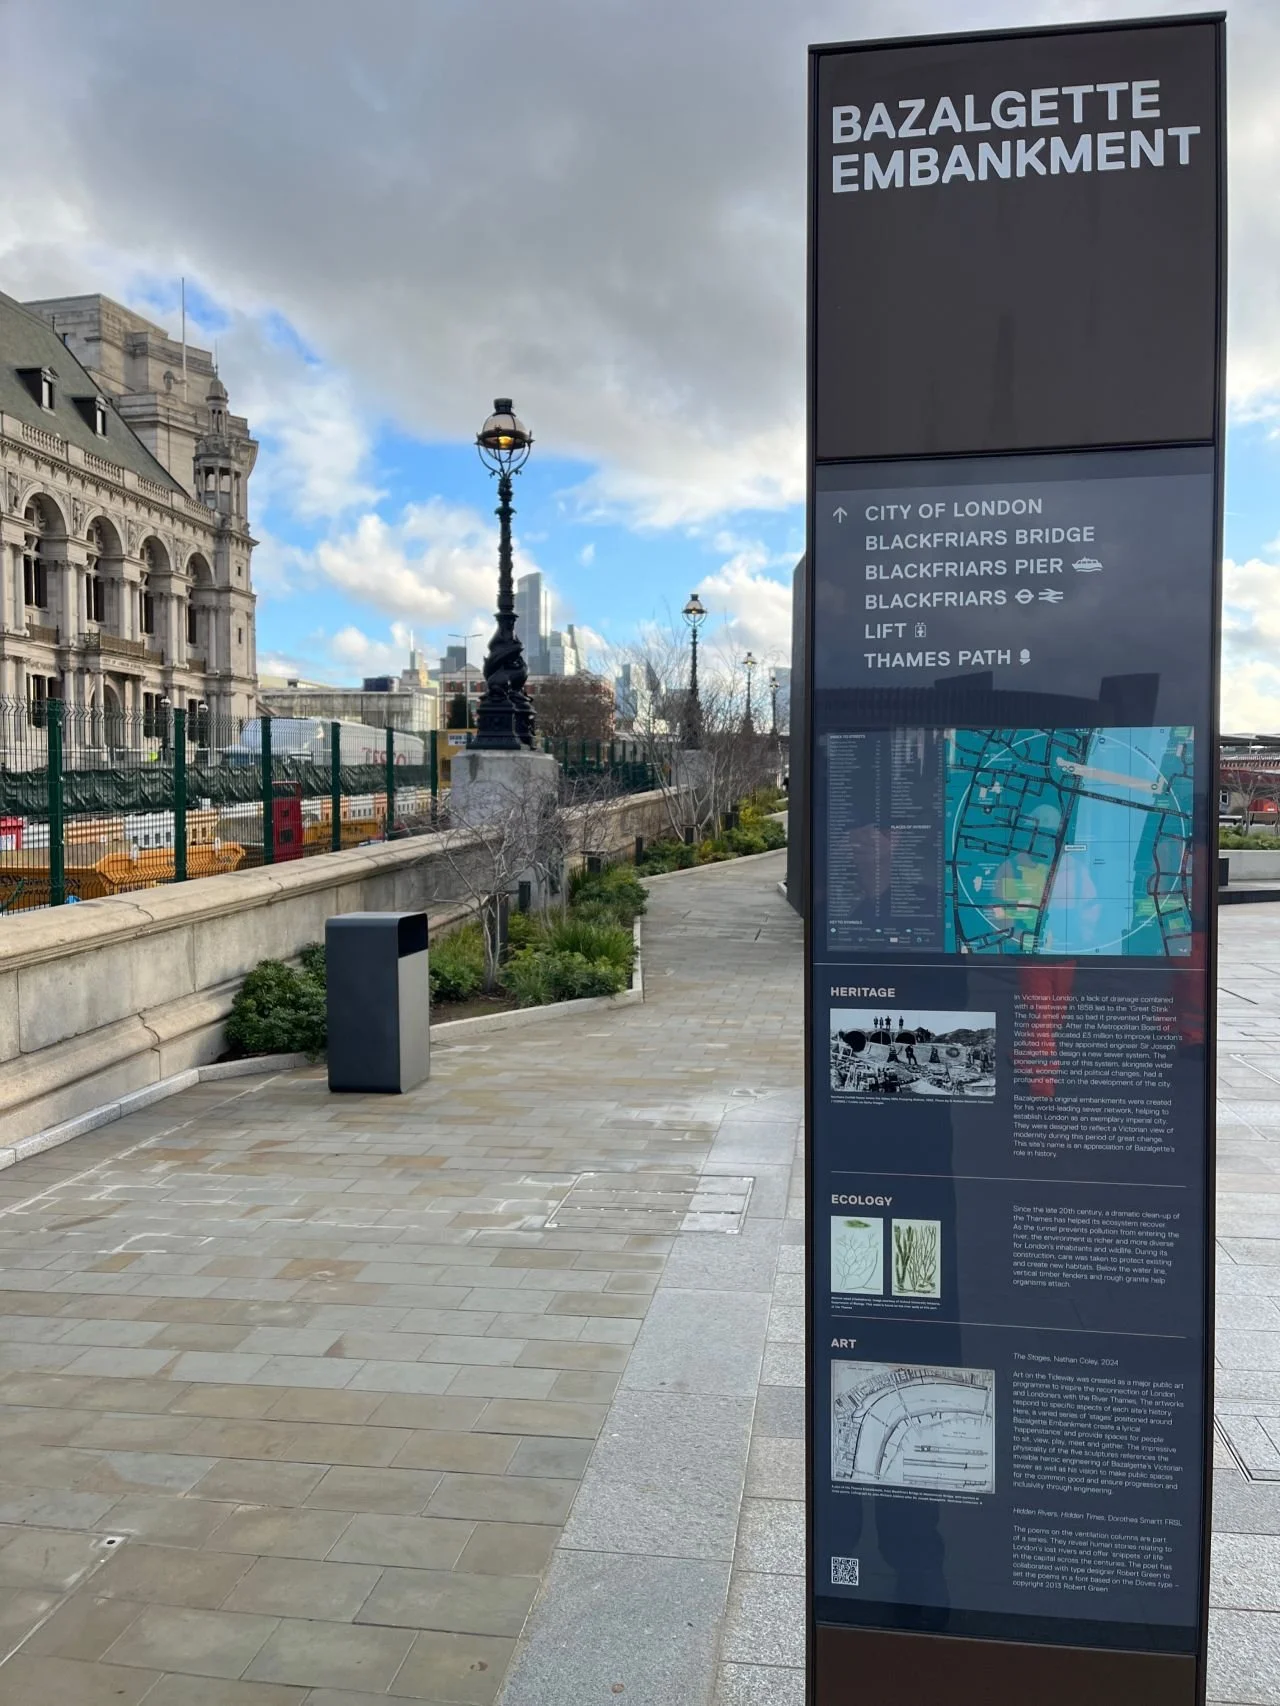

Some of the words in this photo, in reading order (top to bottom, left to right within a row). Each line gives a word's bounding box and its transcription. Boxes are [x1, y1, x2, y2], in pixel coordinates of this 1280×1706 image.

[832, 80, 1161, 144] BAZALGETTE
[832, 126, 1201, 194] EMBANKMENT
[865, 504, 912, 522] CITY
[918, 502, 946, 520] OF
[953, 498, 1042, 519] LONDON
[865, 530, 1007, 551] BLACKFRIARS
[1015, 526, 1095, 545] BRIDGE
[865, 560, 1007, 580] BLACKFRIARS
[1015, 558, 1063, 575] PIER
[865, 589, 1007, 610] BLACKFRIARS
[864, 623, 906, 639] LIFT
[864, 651, 951, 669] THAMES
[958, 649, 1011, 666] PATH
[831, 986, 896, 998] HERITAGE
[1014, 1122, 1029, 1130] They
[1049, 1133, 1069, 1141] during
[1086, 1134, 1106, 1143] period
[1117, 1135, 1134, 1144] great
[831, 1194, 893, 1206] ECOLOGY
[1090, 1255, 1108, 1263] taken
[1104, 1274, 1123, 1283] rough
[1151, 1277, 1165, 1286] help
[831, 1338, 857, 1349] ART
[1068, 1476, 1084, 1485] good
[1028, 1528, 1049, 1536] poems
[1152, 1536, 1166, 1545] part
[1071, 1566, 1085, 1575] type
[1117, 1569, 1139, 1577] Robert
[1141, 1571, 1161, 1579] Green
[1064, 1583, 1086, 1591] Robert
